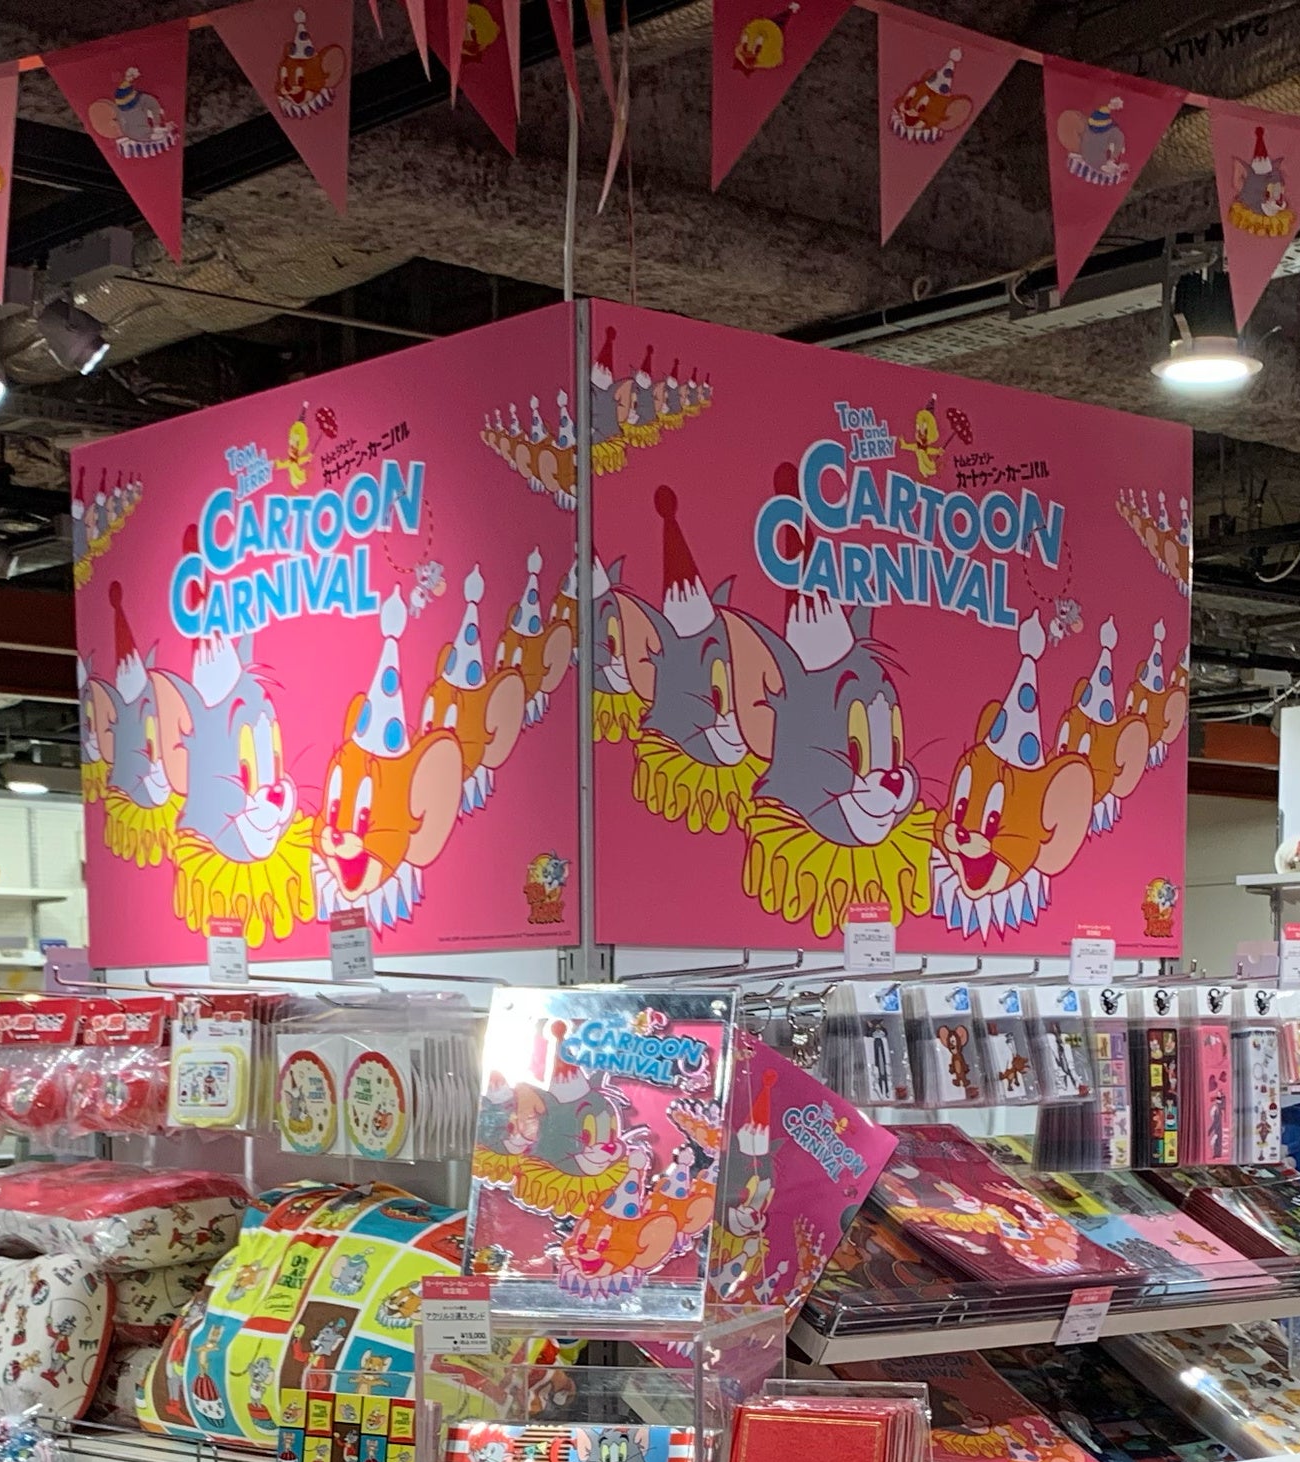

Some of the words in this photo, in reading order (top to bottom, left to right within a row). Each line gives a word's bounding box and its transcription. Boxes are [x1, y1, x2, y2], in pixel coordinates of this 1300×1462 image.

[835, 402, 876, 431] TOM
[864, 421, 888, 439] and
[225, 442, 259, 476] TOM
[849, 433, 897, 462] JERRY
[235, 462, 273, 499] JERRY
[199, 460, 425, 574] CARTOON
[799, 440, 1065, 570] CARTOON
[755, 495, 1019, 630] CARNIVAL
[170, 545, 380, 638] CARNIVAL
[561, 1038, 674, 1083] CARNIVAL
[582, 1020, 706, 1064] CARTOON
[782, 1108, 842, 1184] CARNIVAL
[800, 1105, 868, 1178] CARTOON
